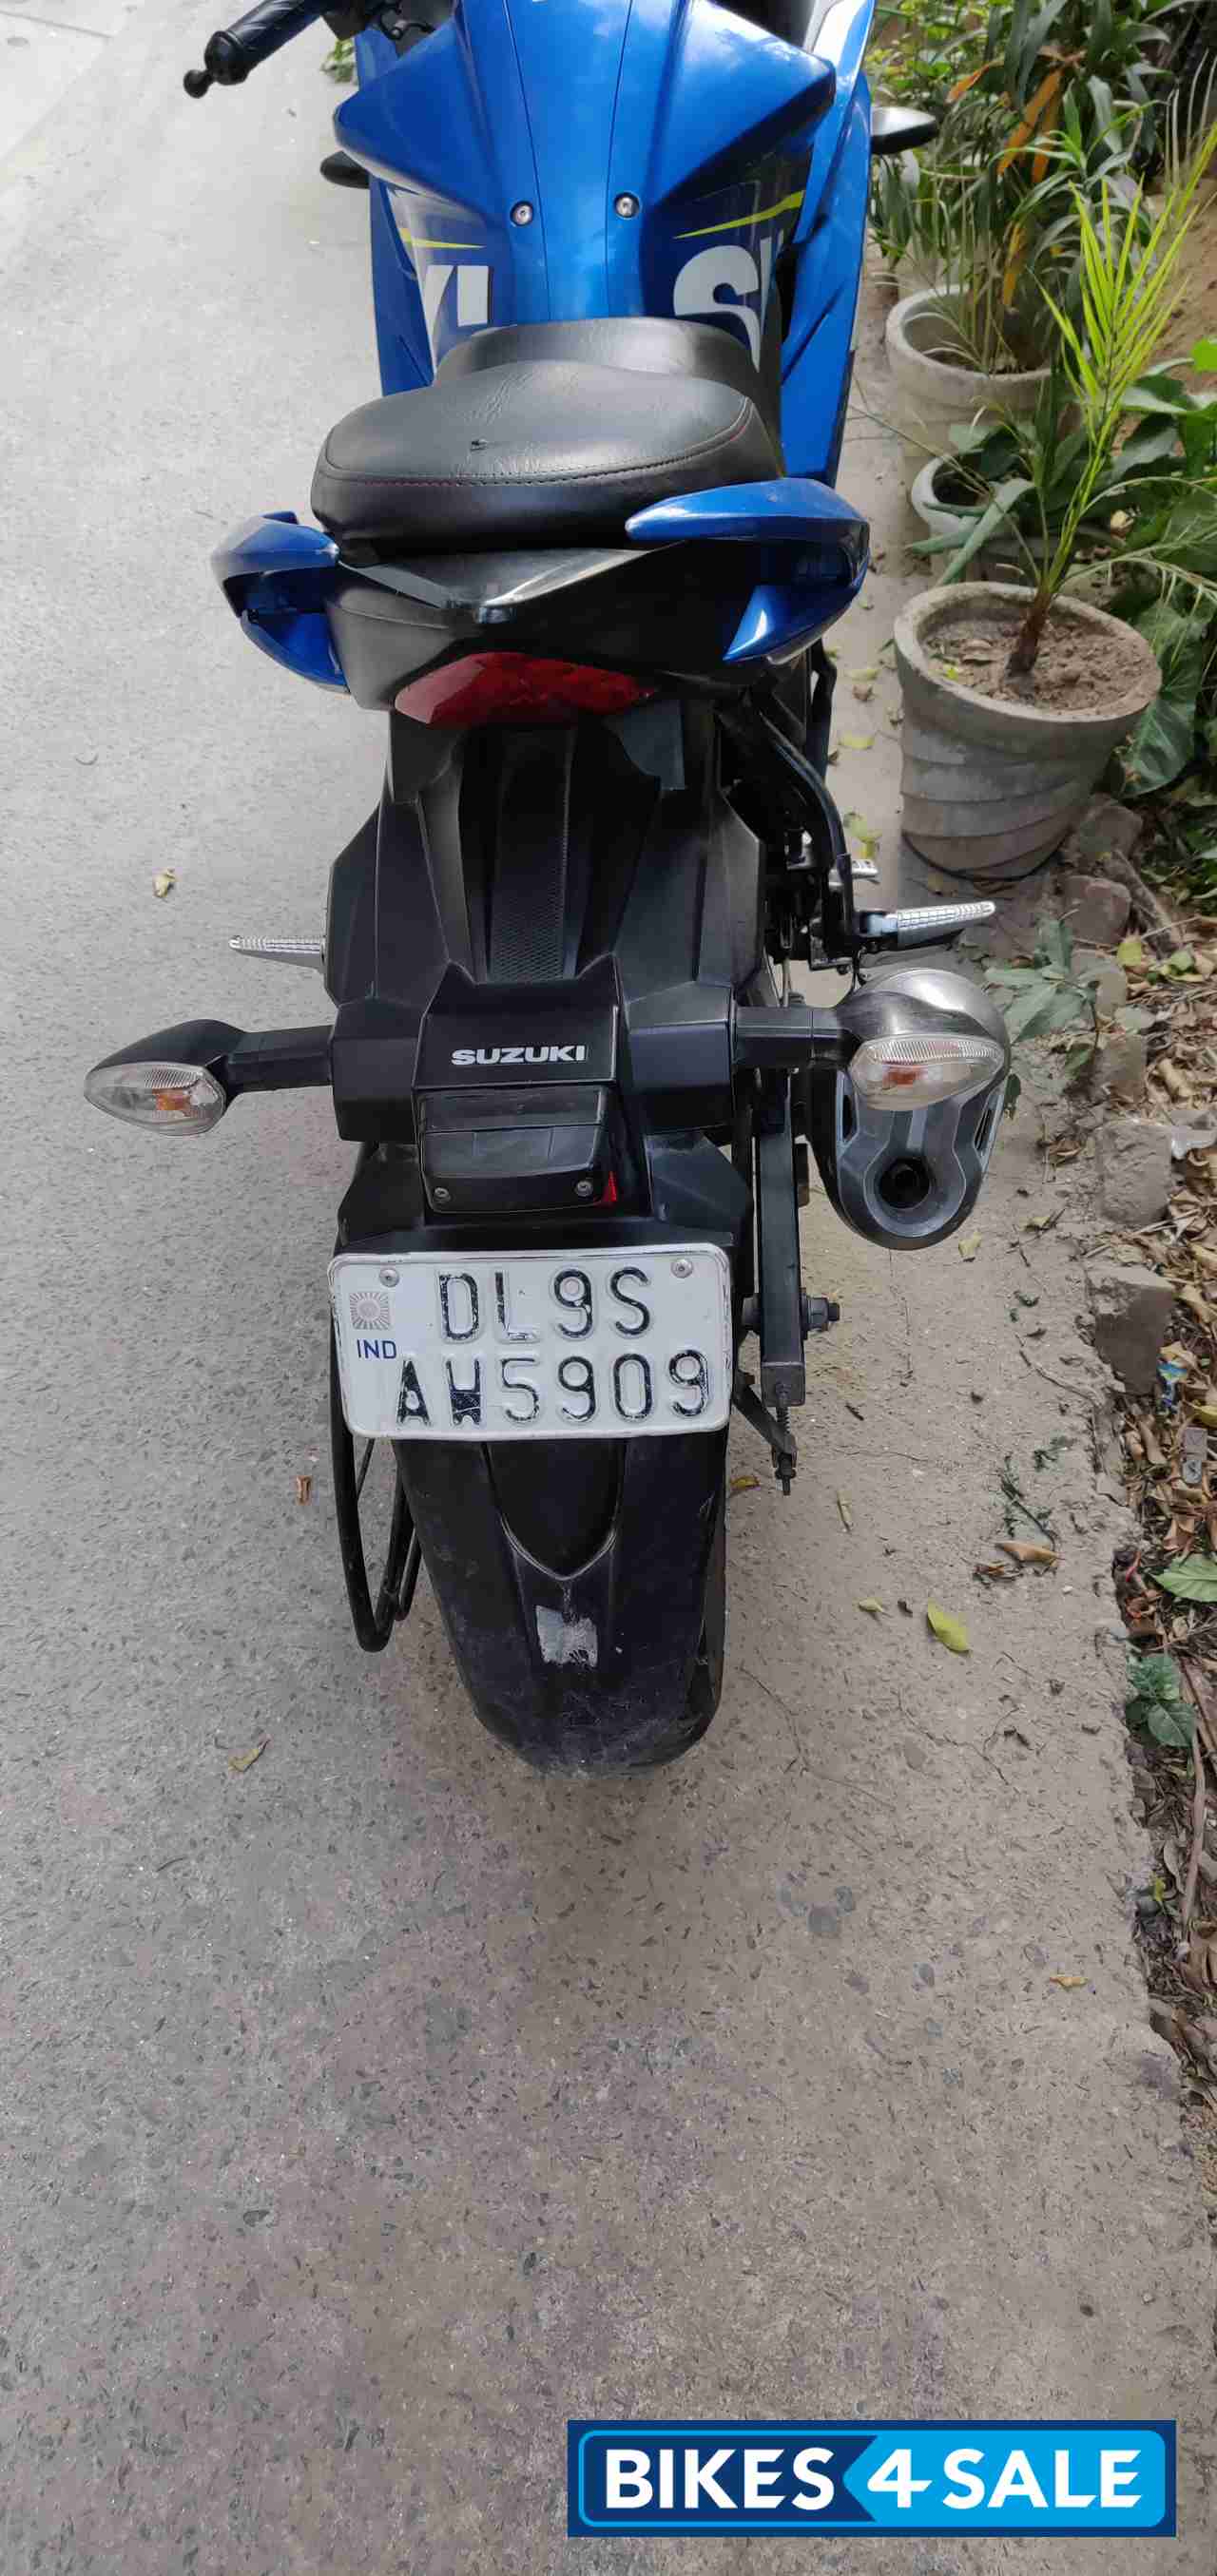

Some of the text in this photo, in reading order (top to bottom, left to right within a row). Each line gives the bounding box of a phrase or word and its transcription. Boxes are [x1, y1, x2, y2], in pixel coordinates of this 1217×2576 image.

[451, 1046, 587, 1066] SUZUKI
[438, 1266, 652, 1341] DL9S
[356, 1339, 397, 1360] IND
[396, 1350, 709, 1426] AW5909
